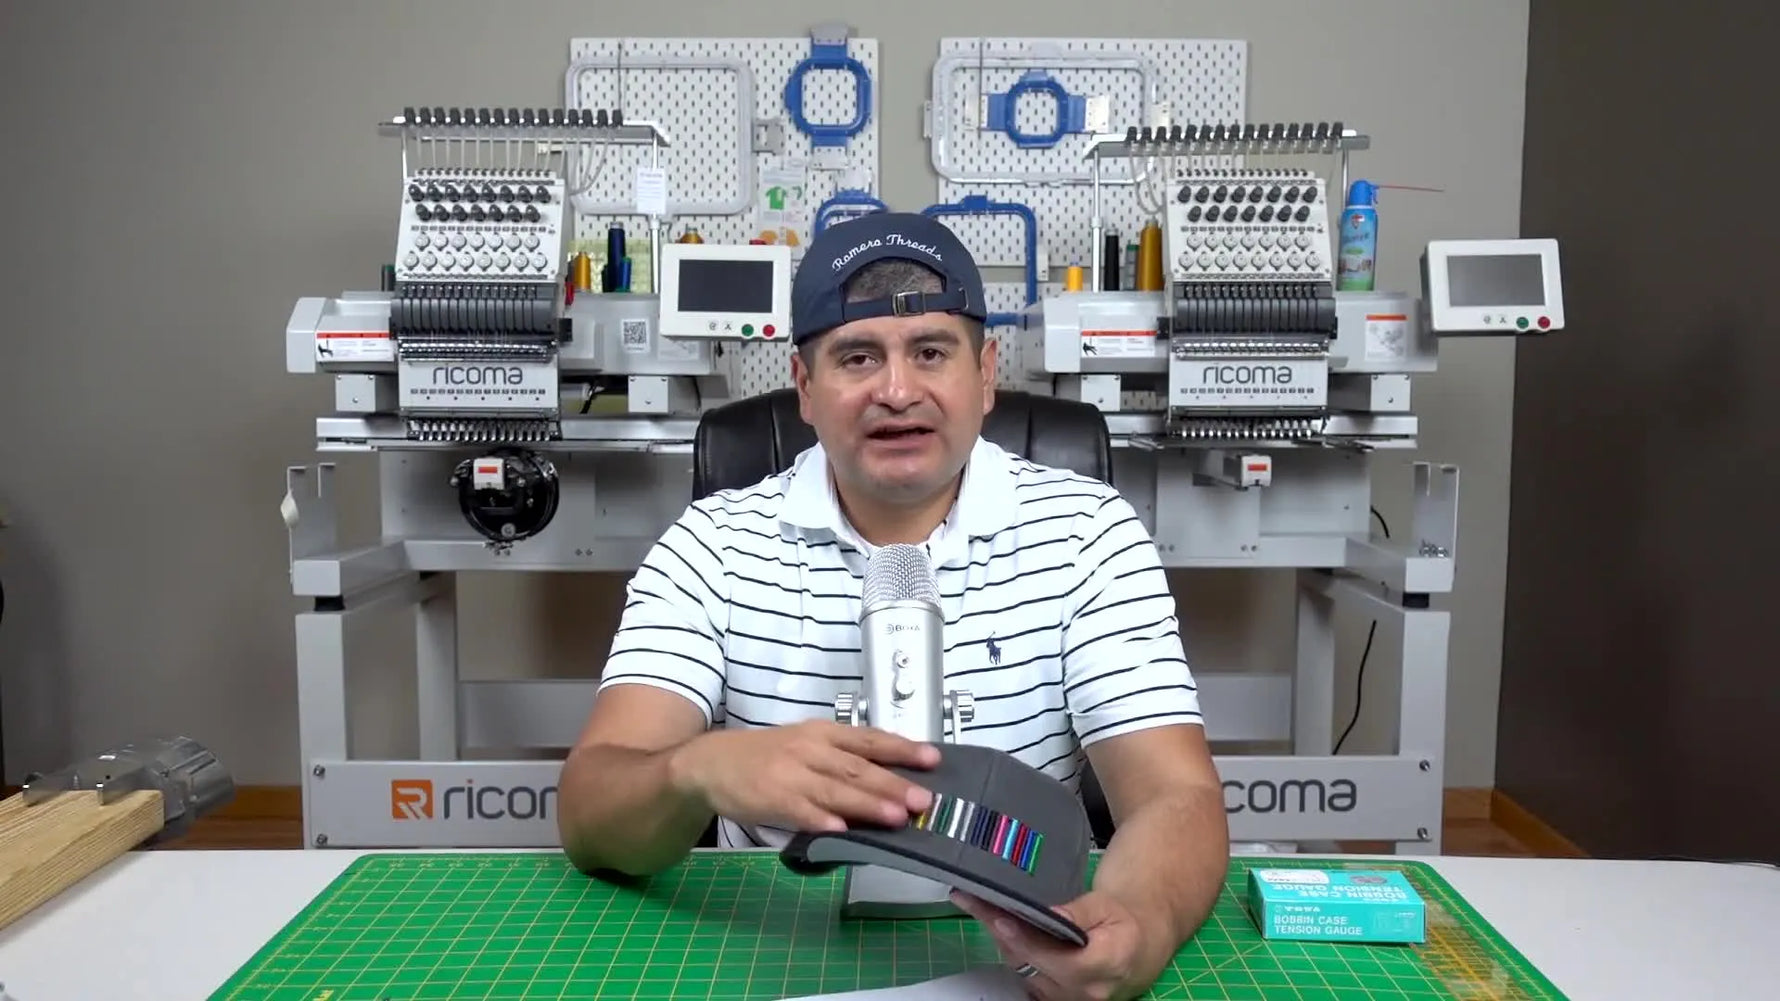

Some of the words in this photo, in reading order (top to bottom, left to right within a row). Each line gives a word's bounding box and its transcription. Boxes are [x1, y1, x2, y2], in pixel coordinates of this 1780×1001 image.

[832, 239, 882, 271] Romero
[886, 234, 942, 261] Threads
[433, 363, 523, 385] ricoma
[1203, 363, 1292, 384] ricoma
[443, 779, 558, 820] rico
[1222, 779, 1357, 813] coma
[1274, 915, 1314, 925] BOBBIN
[1318, 916, 1348, 925] CASE
[1274, 925, 1321, 935] TENSION
[1325, 926, 1362, 935] GAUGE
